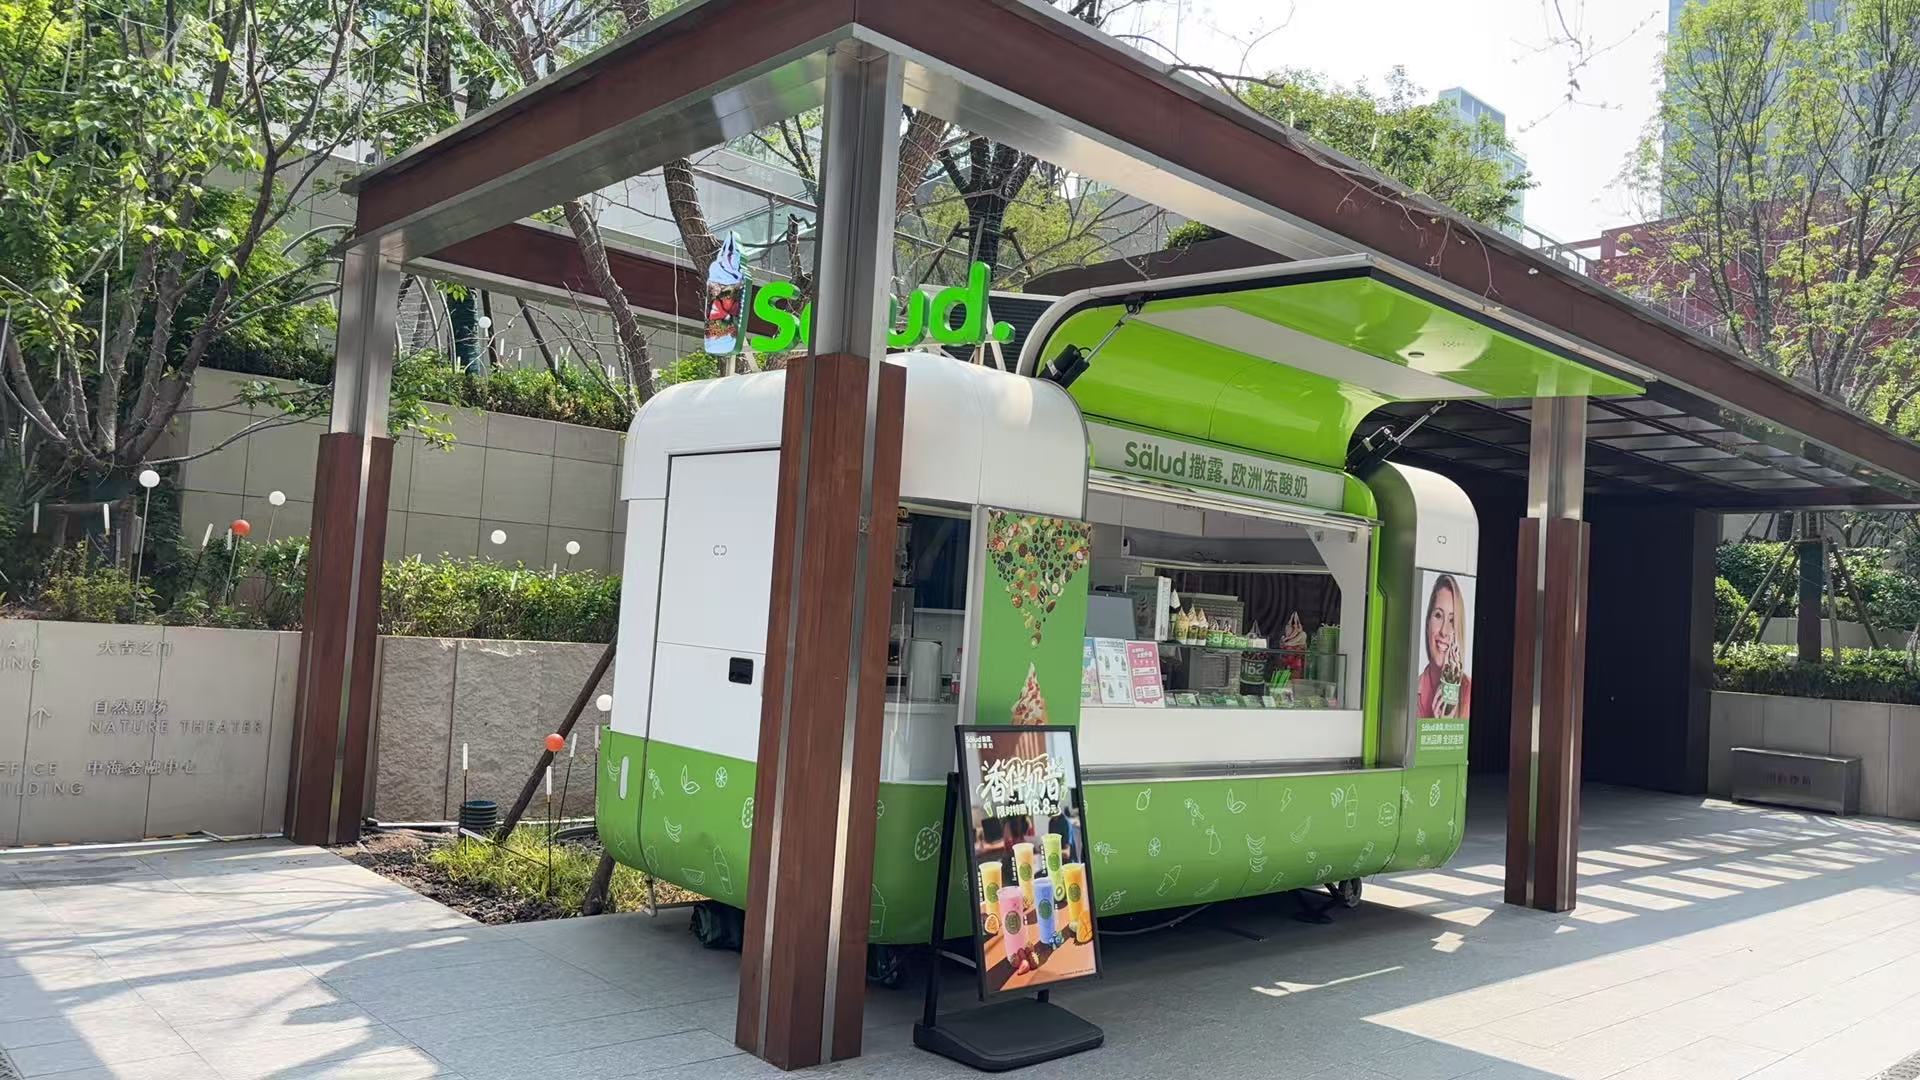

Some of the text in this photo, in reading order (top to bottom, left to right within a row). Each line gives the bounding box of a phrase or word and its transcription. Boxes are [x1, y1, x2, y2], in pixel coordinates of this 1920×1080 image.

[749, 261, 1016, 352] Sud.
[1124, 441, 1186, 477] Sälud
[95, 701, 167, 715] 自然剧场
[90, 720, 263, 733] NATURE THEATER
[87, 760, 195, 776] 中海金融中心
